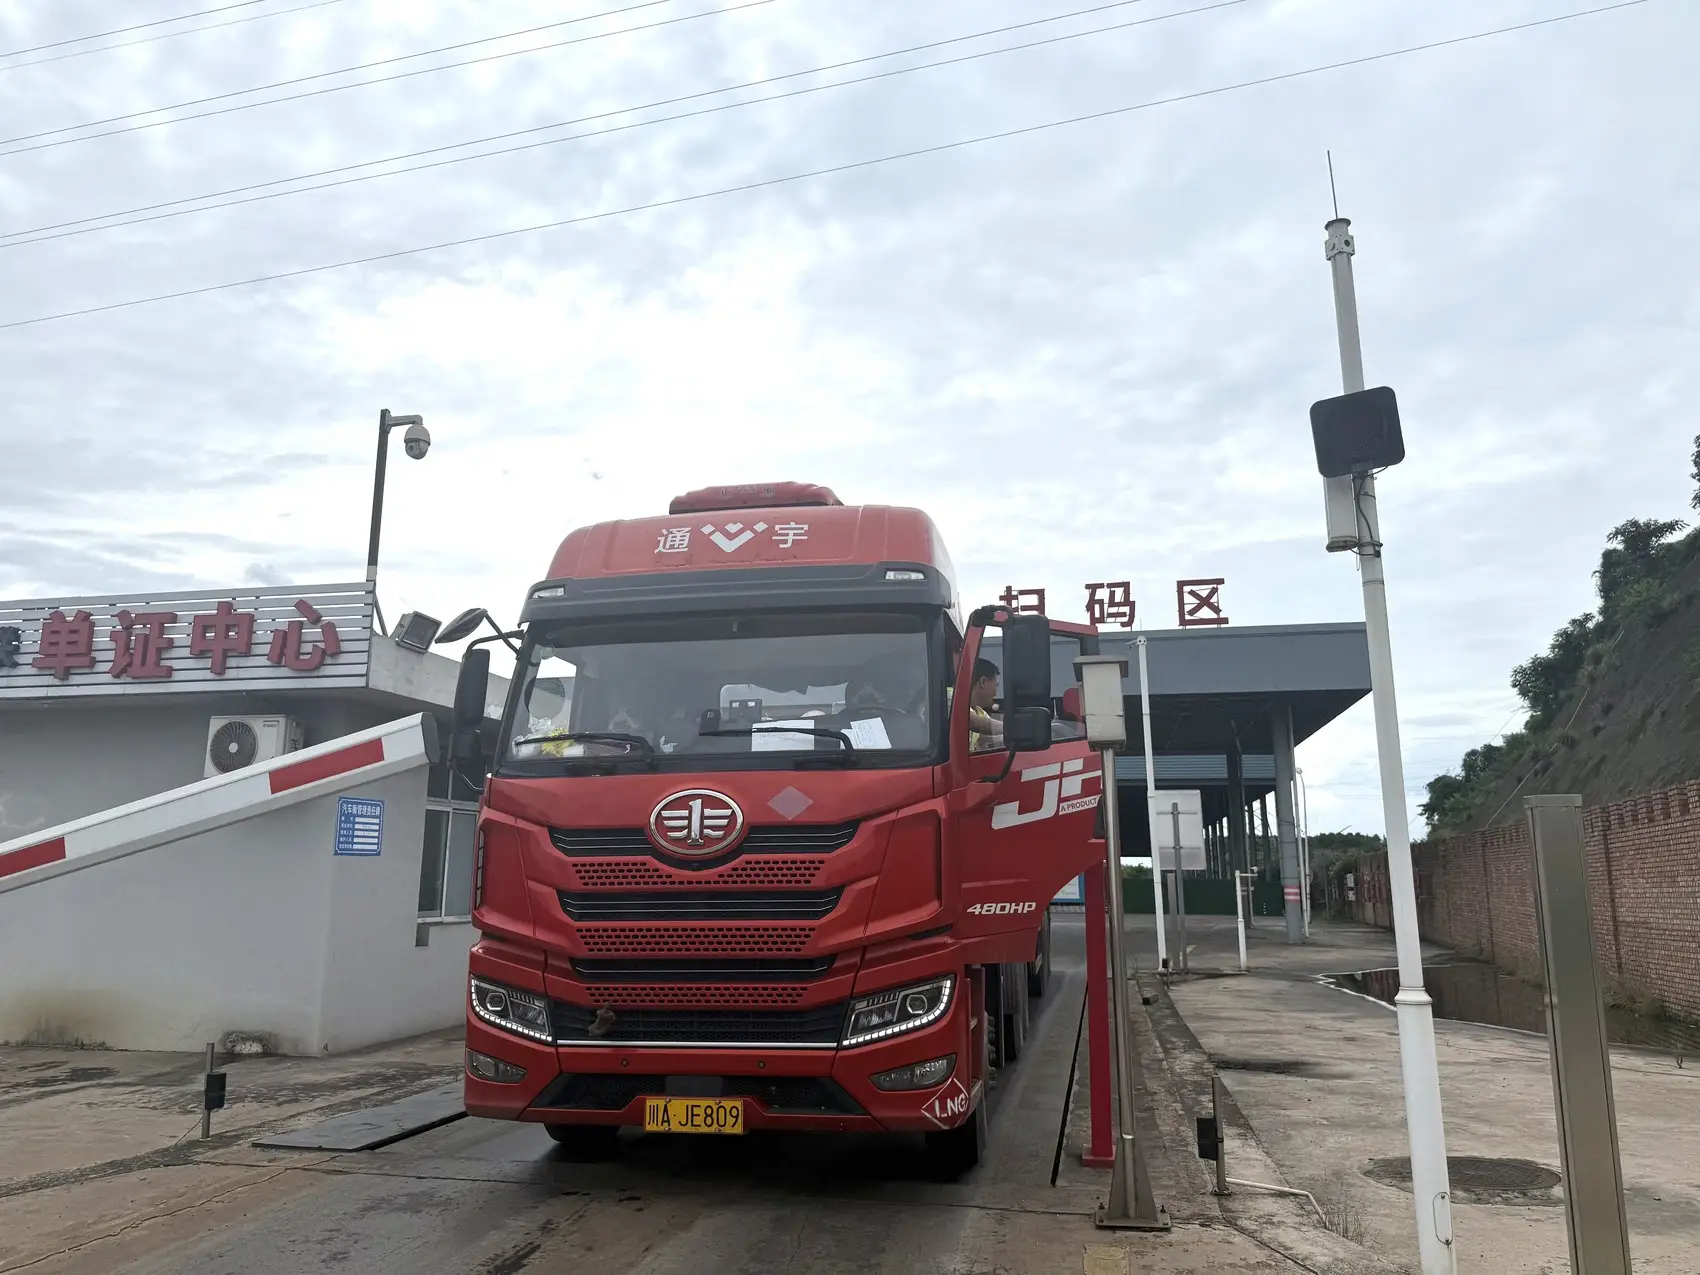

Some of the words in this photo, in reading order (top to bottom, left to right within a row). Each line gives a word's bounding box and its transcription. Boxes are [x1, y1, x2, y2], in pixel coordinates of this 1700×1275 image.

[654, 527, 692, 554] 通
[772, 521, 808, 548] 宇
[31, 598, 342, 680] 单证中心
[1066, 797, 1098, 812] PRODUCT
[966, 902, 1037, 915] 480HP
[934, 1092, 966, 1118] LNG
